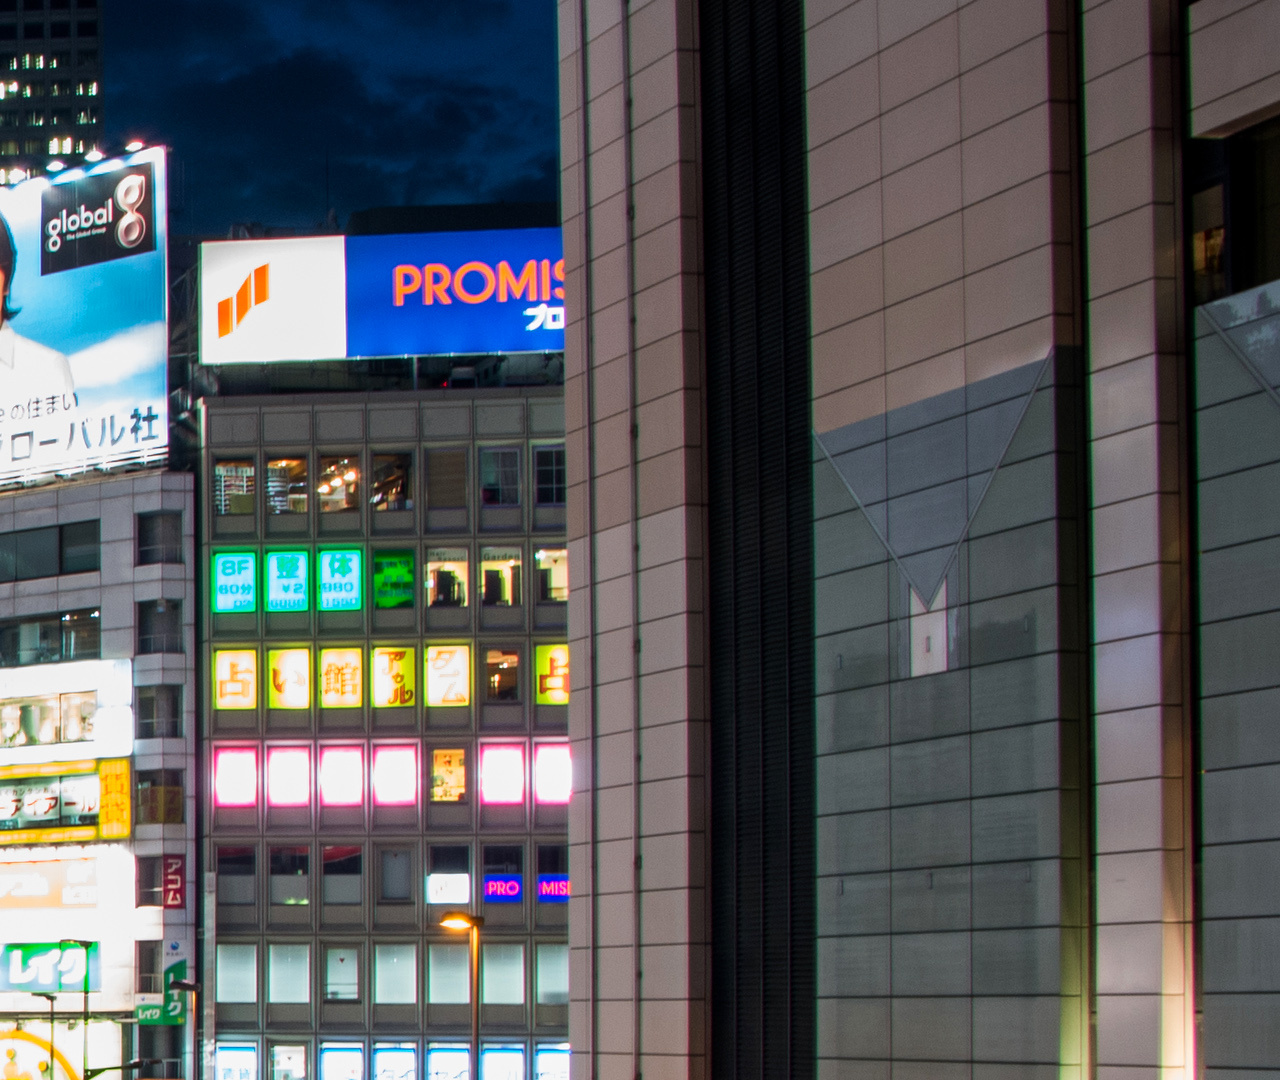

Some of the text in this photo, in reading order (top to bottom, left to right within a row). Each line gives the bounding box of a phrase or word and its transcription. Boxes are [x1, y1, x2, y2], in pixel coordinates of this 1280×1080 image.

[44, 198, 113, 252] global
[10, 391, 79, 421] の住まい
[221, 559, 250, 577] 8F
[167, 858, 182, 906] アコム
[487, 881, 519, 895] PRO
[9, 948, 88, 986] レイク
[138, 1008, 162, 1020] レイク
